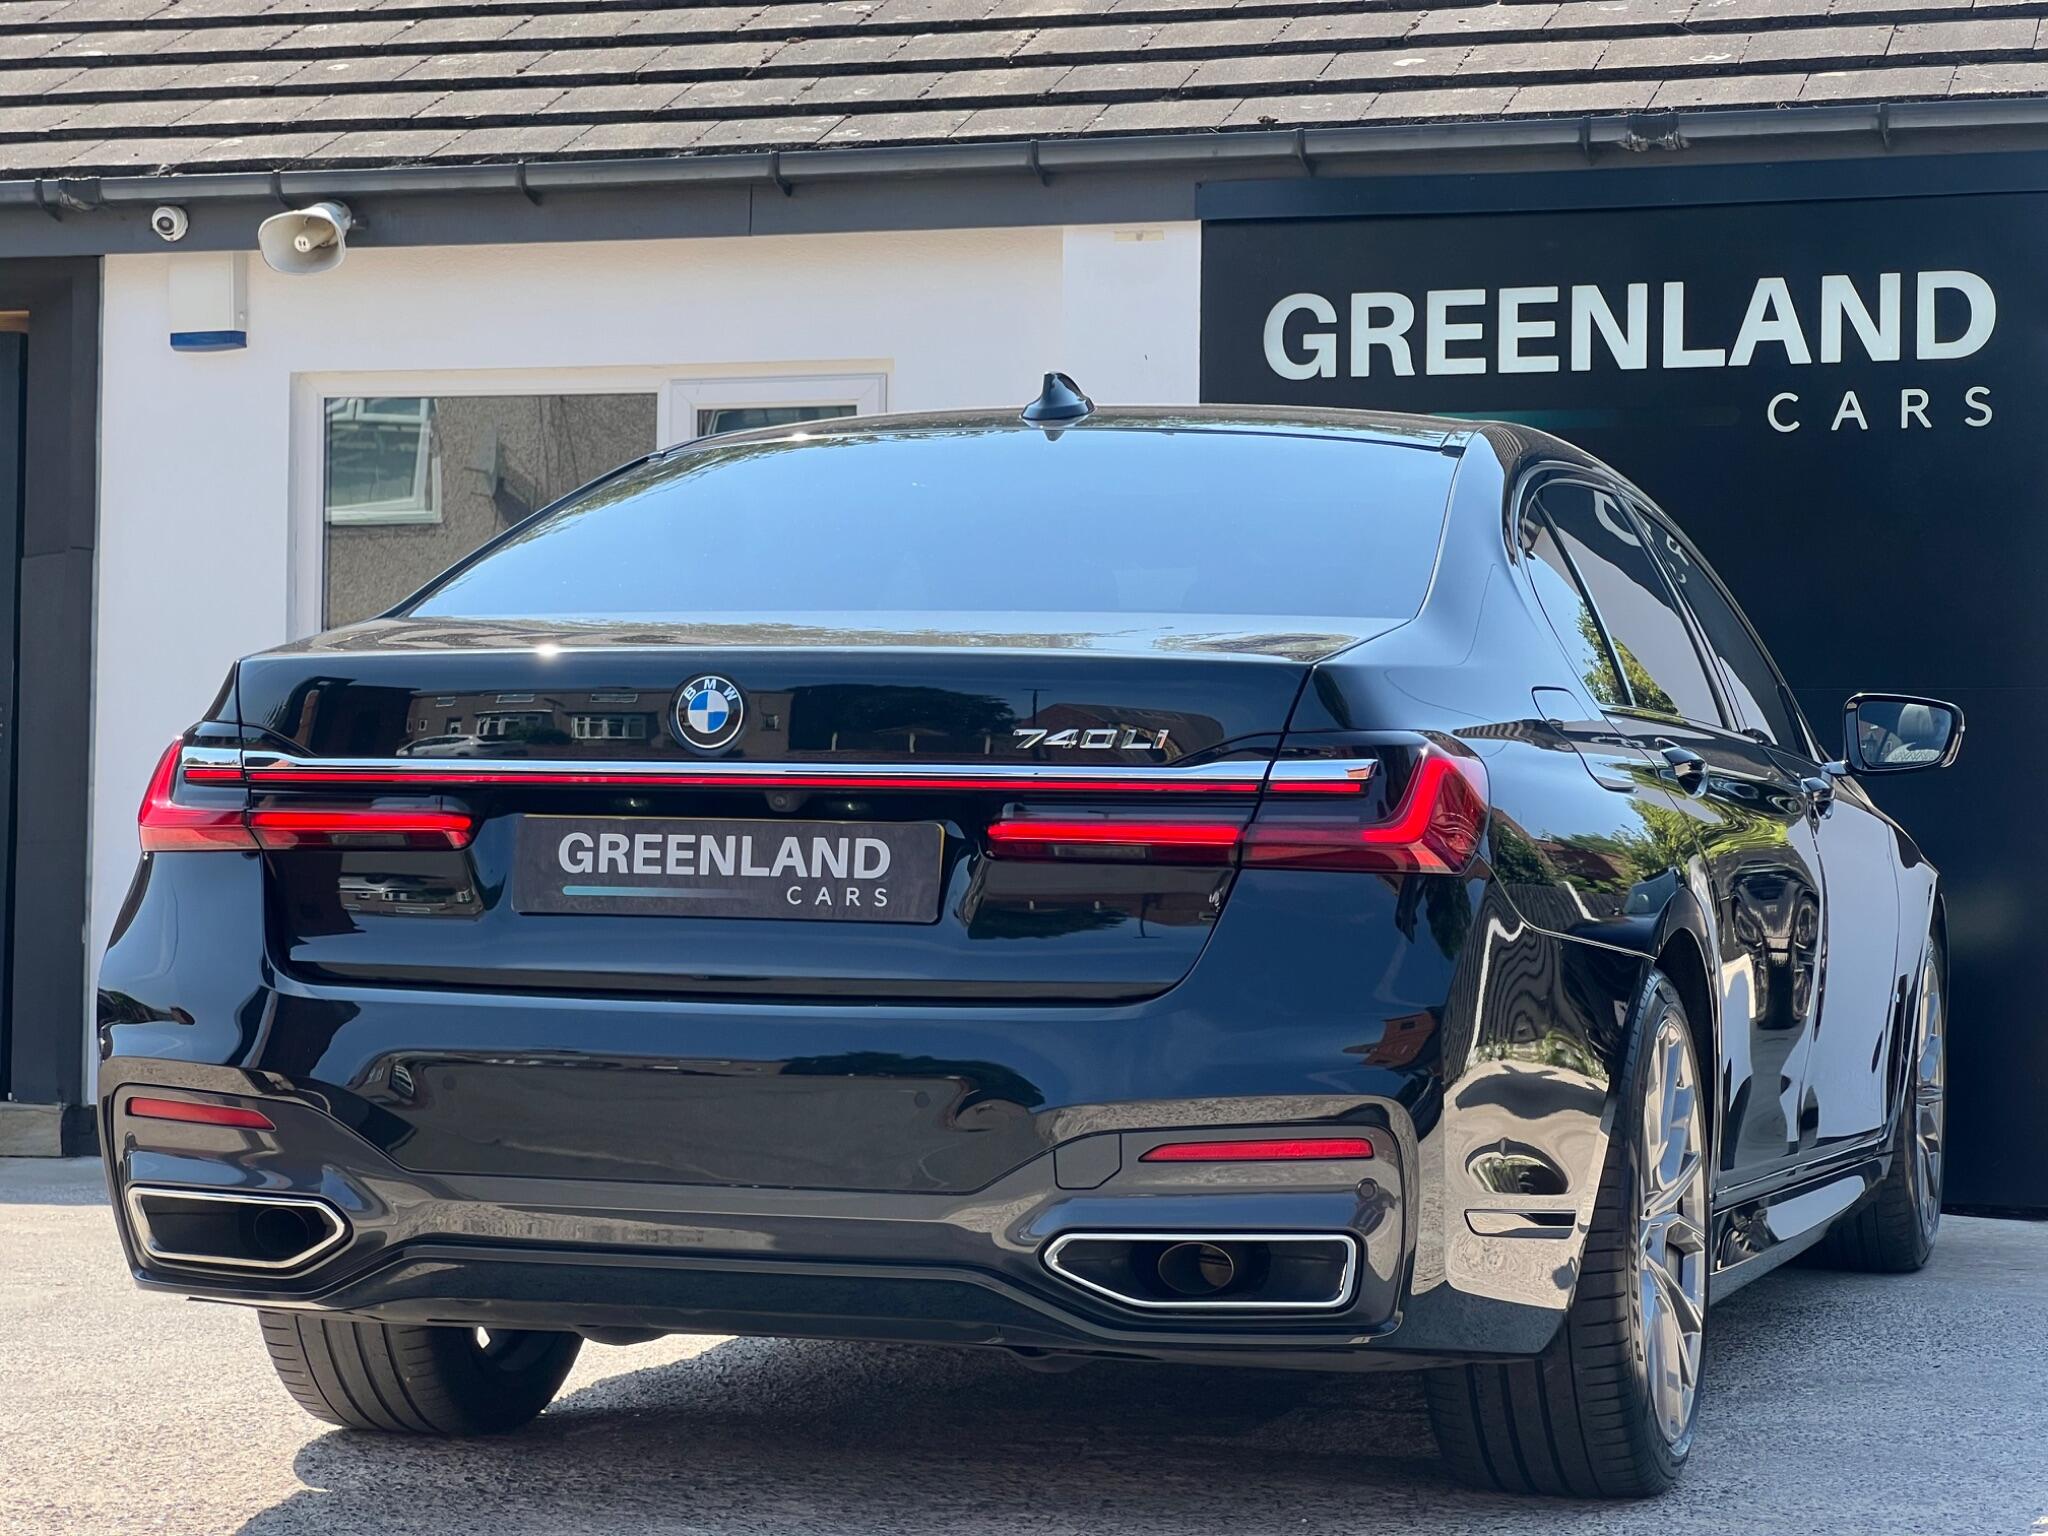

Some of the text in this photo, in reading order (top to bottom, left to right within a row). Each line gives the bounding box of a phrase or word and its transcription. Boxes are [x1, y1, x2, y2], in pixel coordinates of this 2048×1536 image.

[1263, 270, 1997, 380] GREENLAND
[1767, 386, 1993, 433] CARS
[684, 679, 738, 701] BMW
[558, 832, 891, 879] GREENLAND
[786, 885, 889, 908] CARS
